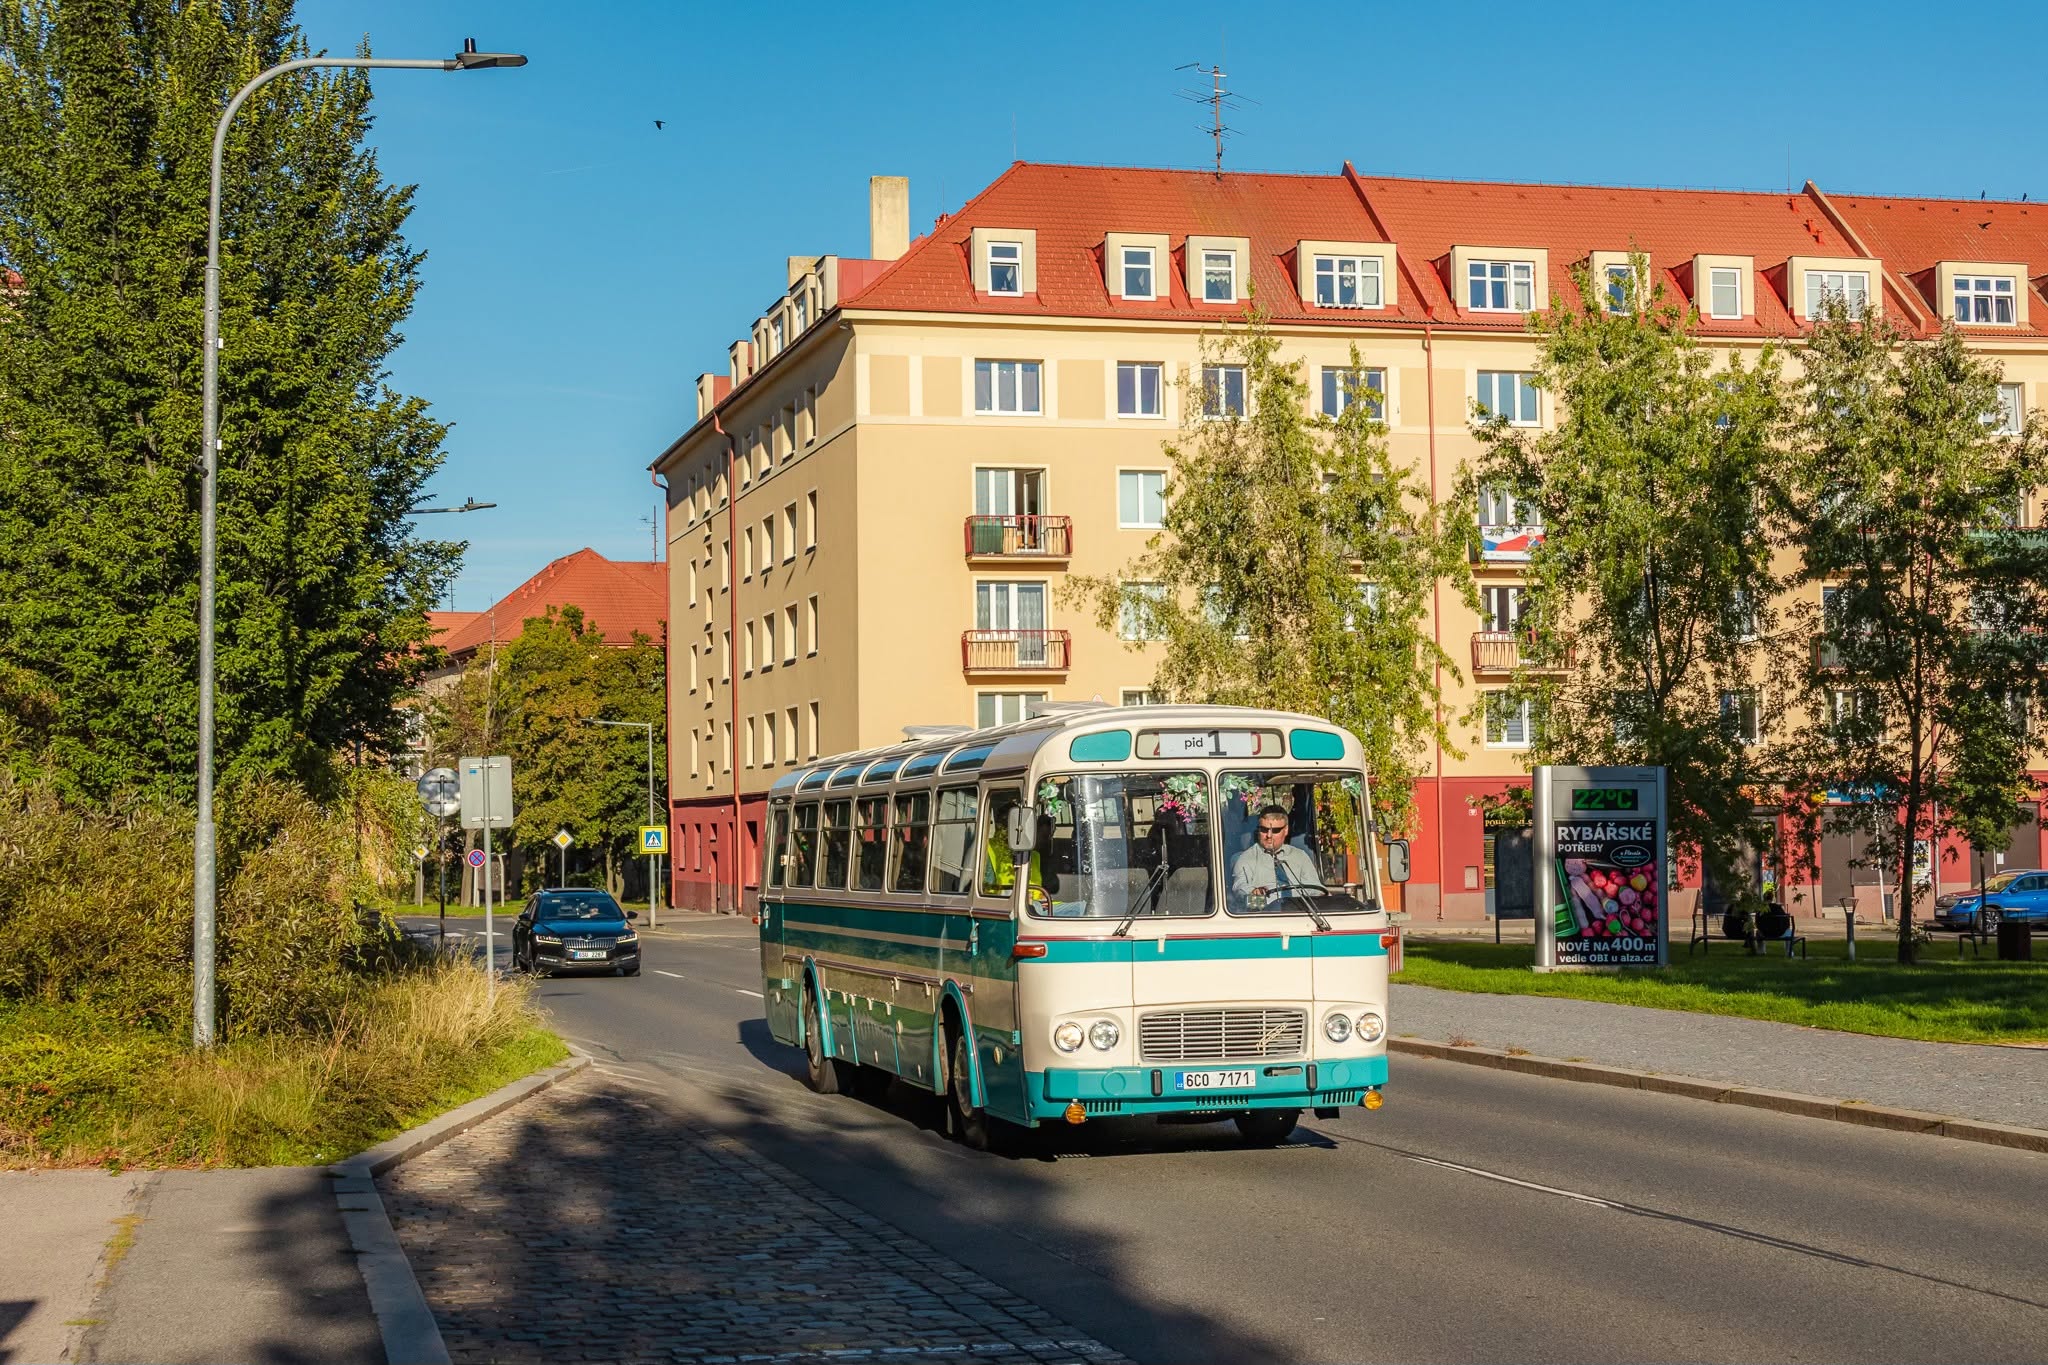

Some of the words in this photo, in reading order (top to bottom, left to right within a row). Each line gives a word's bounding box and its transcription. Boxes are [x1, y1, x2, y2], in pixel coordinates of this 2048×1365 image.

[1184, 737, 1203, 750] pid
[1207, 730, 1227, 757] 1
[1557, 822, 1652, 841] RYBÁŘSKÉ
[1558, 841, 1603, 852] POTŘEBY
[1557, 939, 1590, 952] NOVĚ
[1593, 942, 1610, 951] NA
[1559, 954, 1587, 962] vedle
[1589, 954, 1608, 962] OBI
[1620, 954, 1655, 962] alza.cz
[1219, 1071, 1249, 1086] 7171
